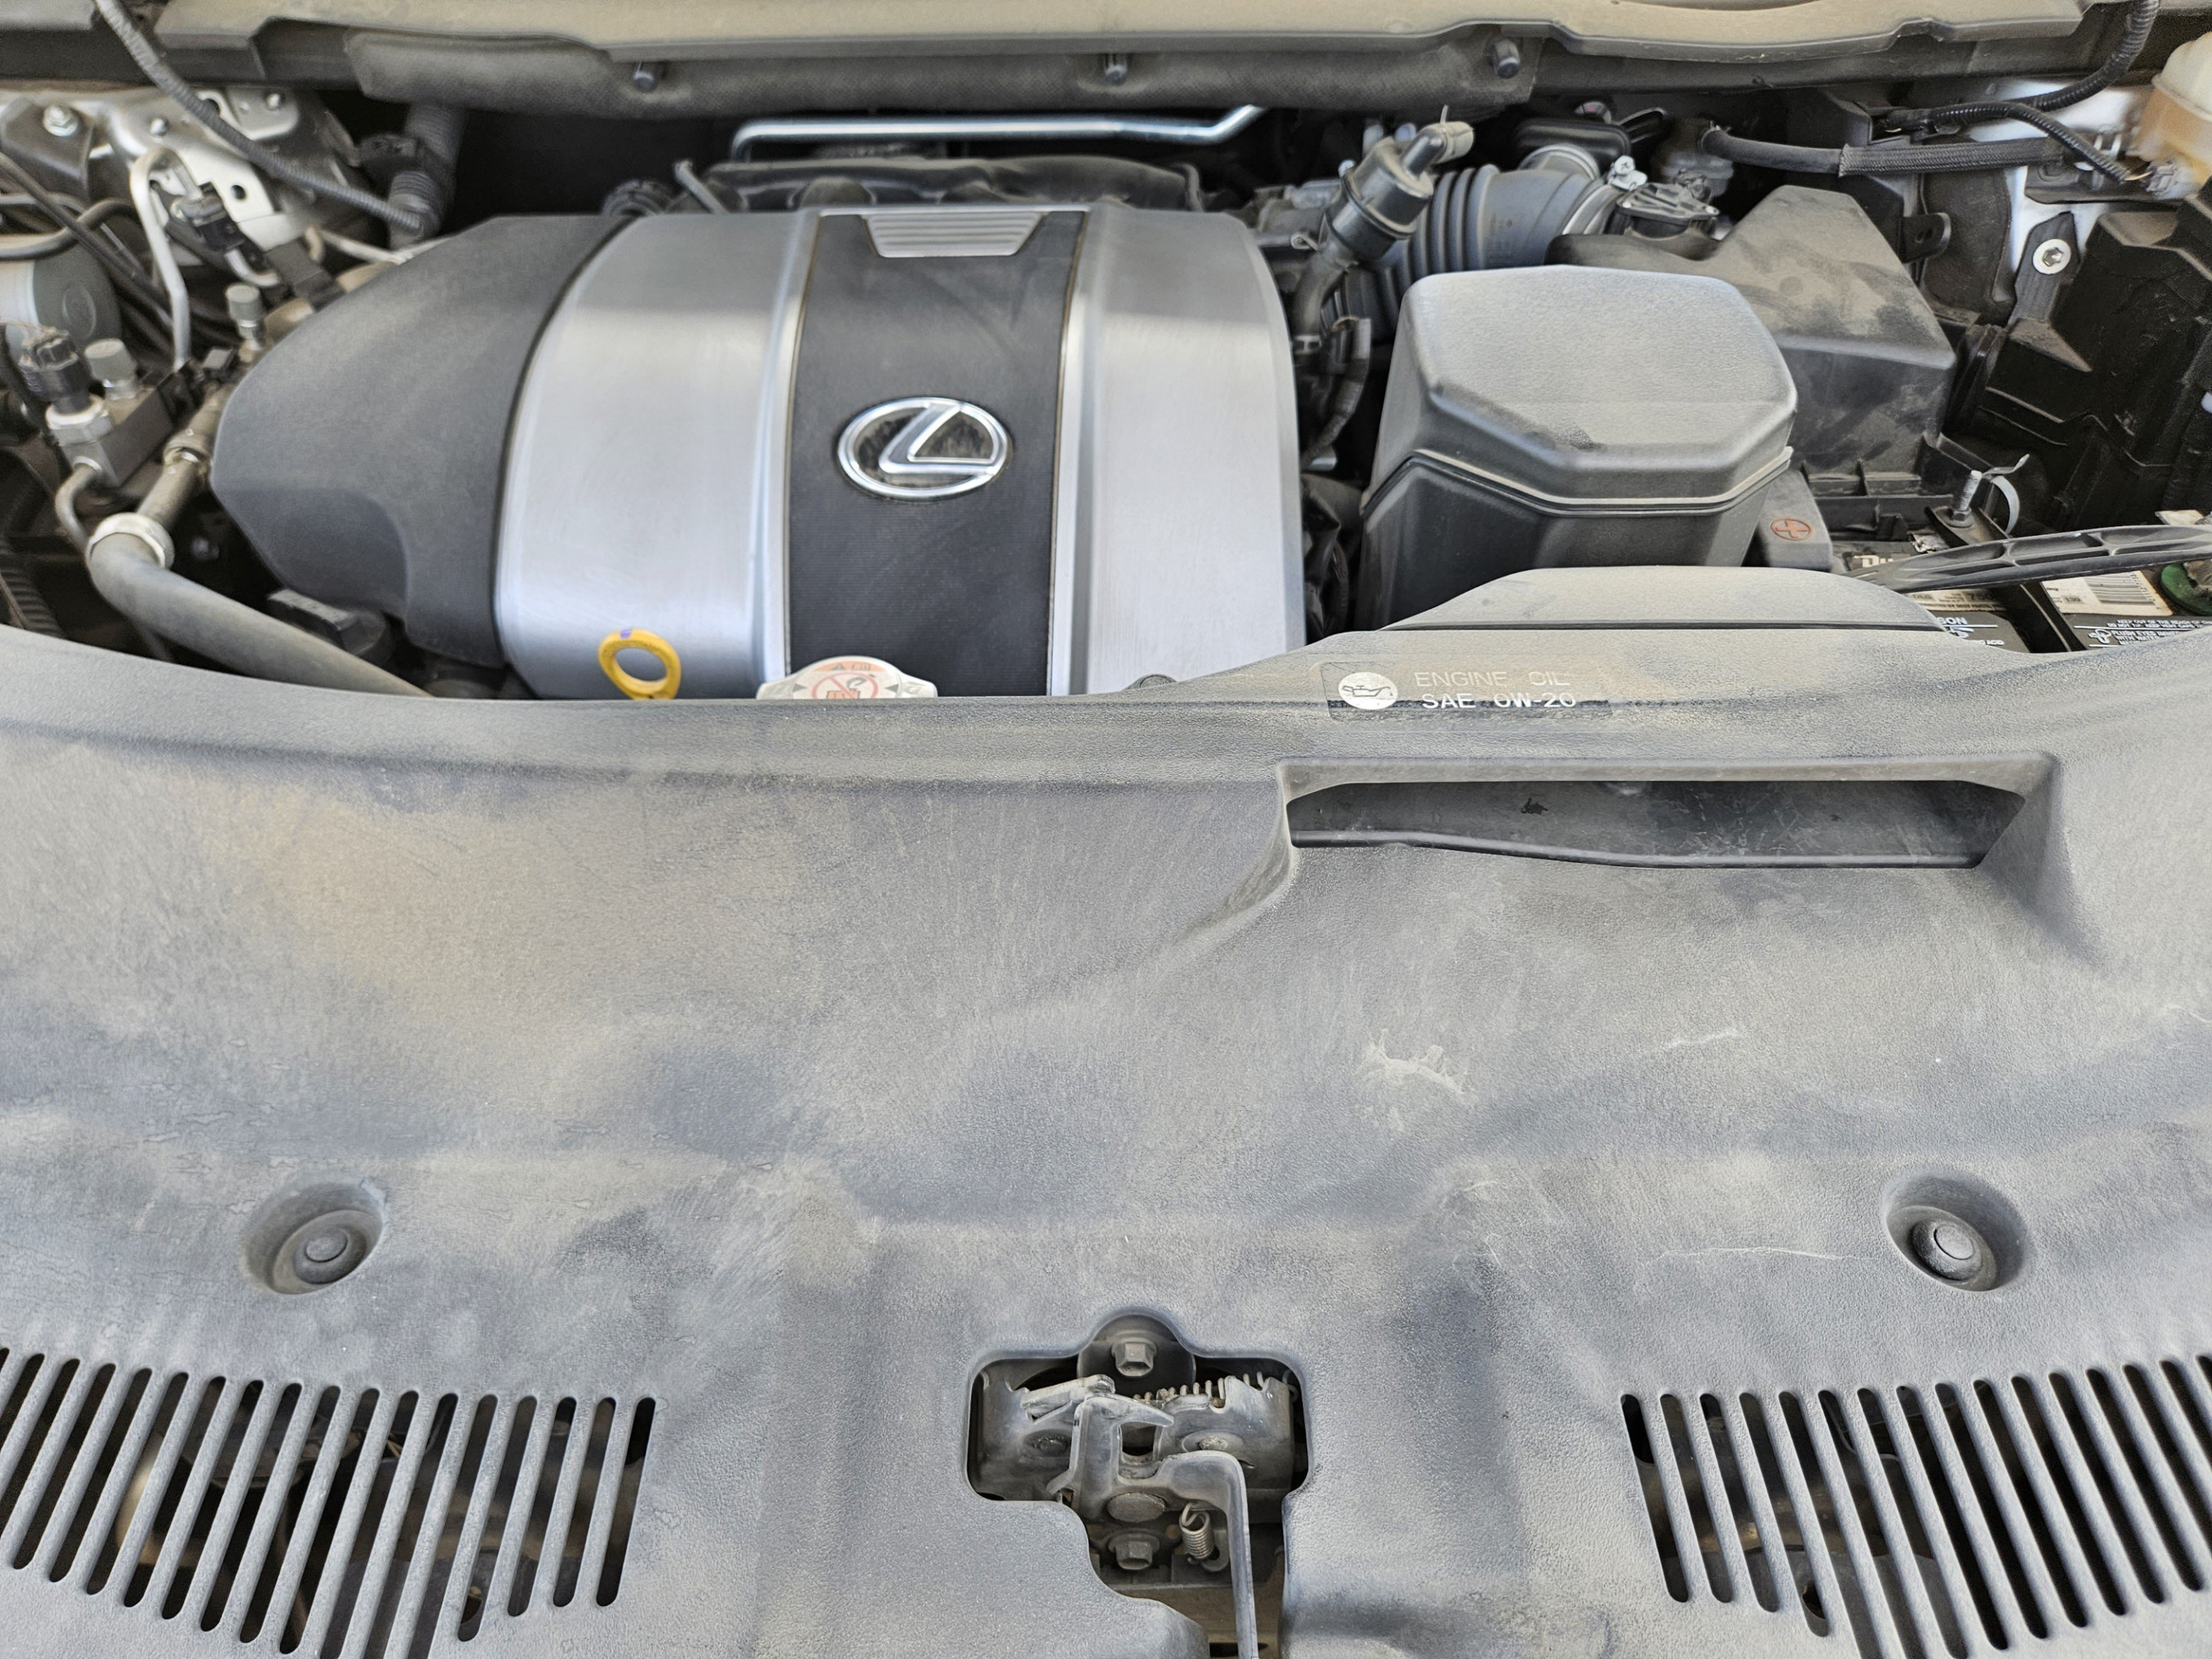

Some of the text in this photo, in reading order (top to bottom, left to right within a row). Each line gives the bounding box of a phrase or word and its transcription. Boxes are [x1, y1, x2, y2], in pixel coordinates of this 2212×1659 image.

[1936, 617, 1968, 625] SON
[1414, 671, 1570, 687] ENGINE OIL
[1421, 691, 1577, 709] SAE 0W-20
